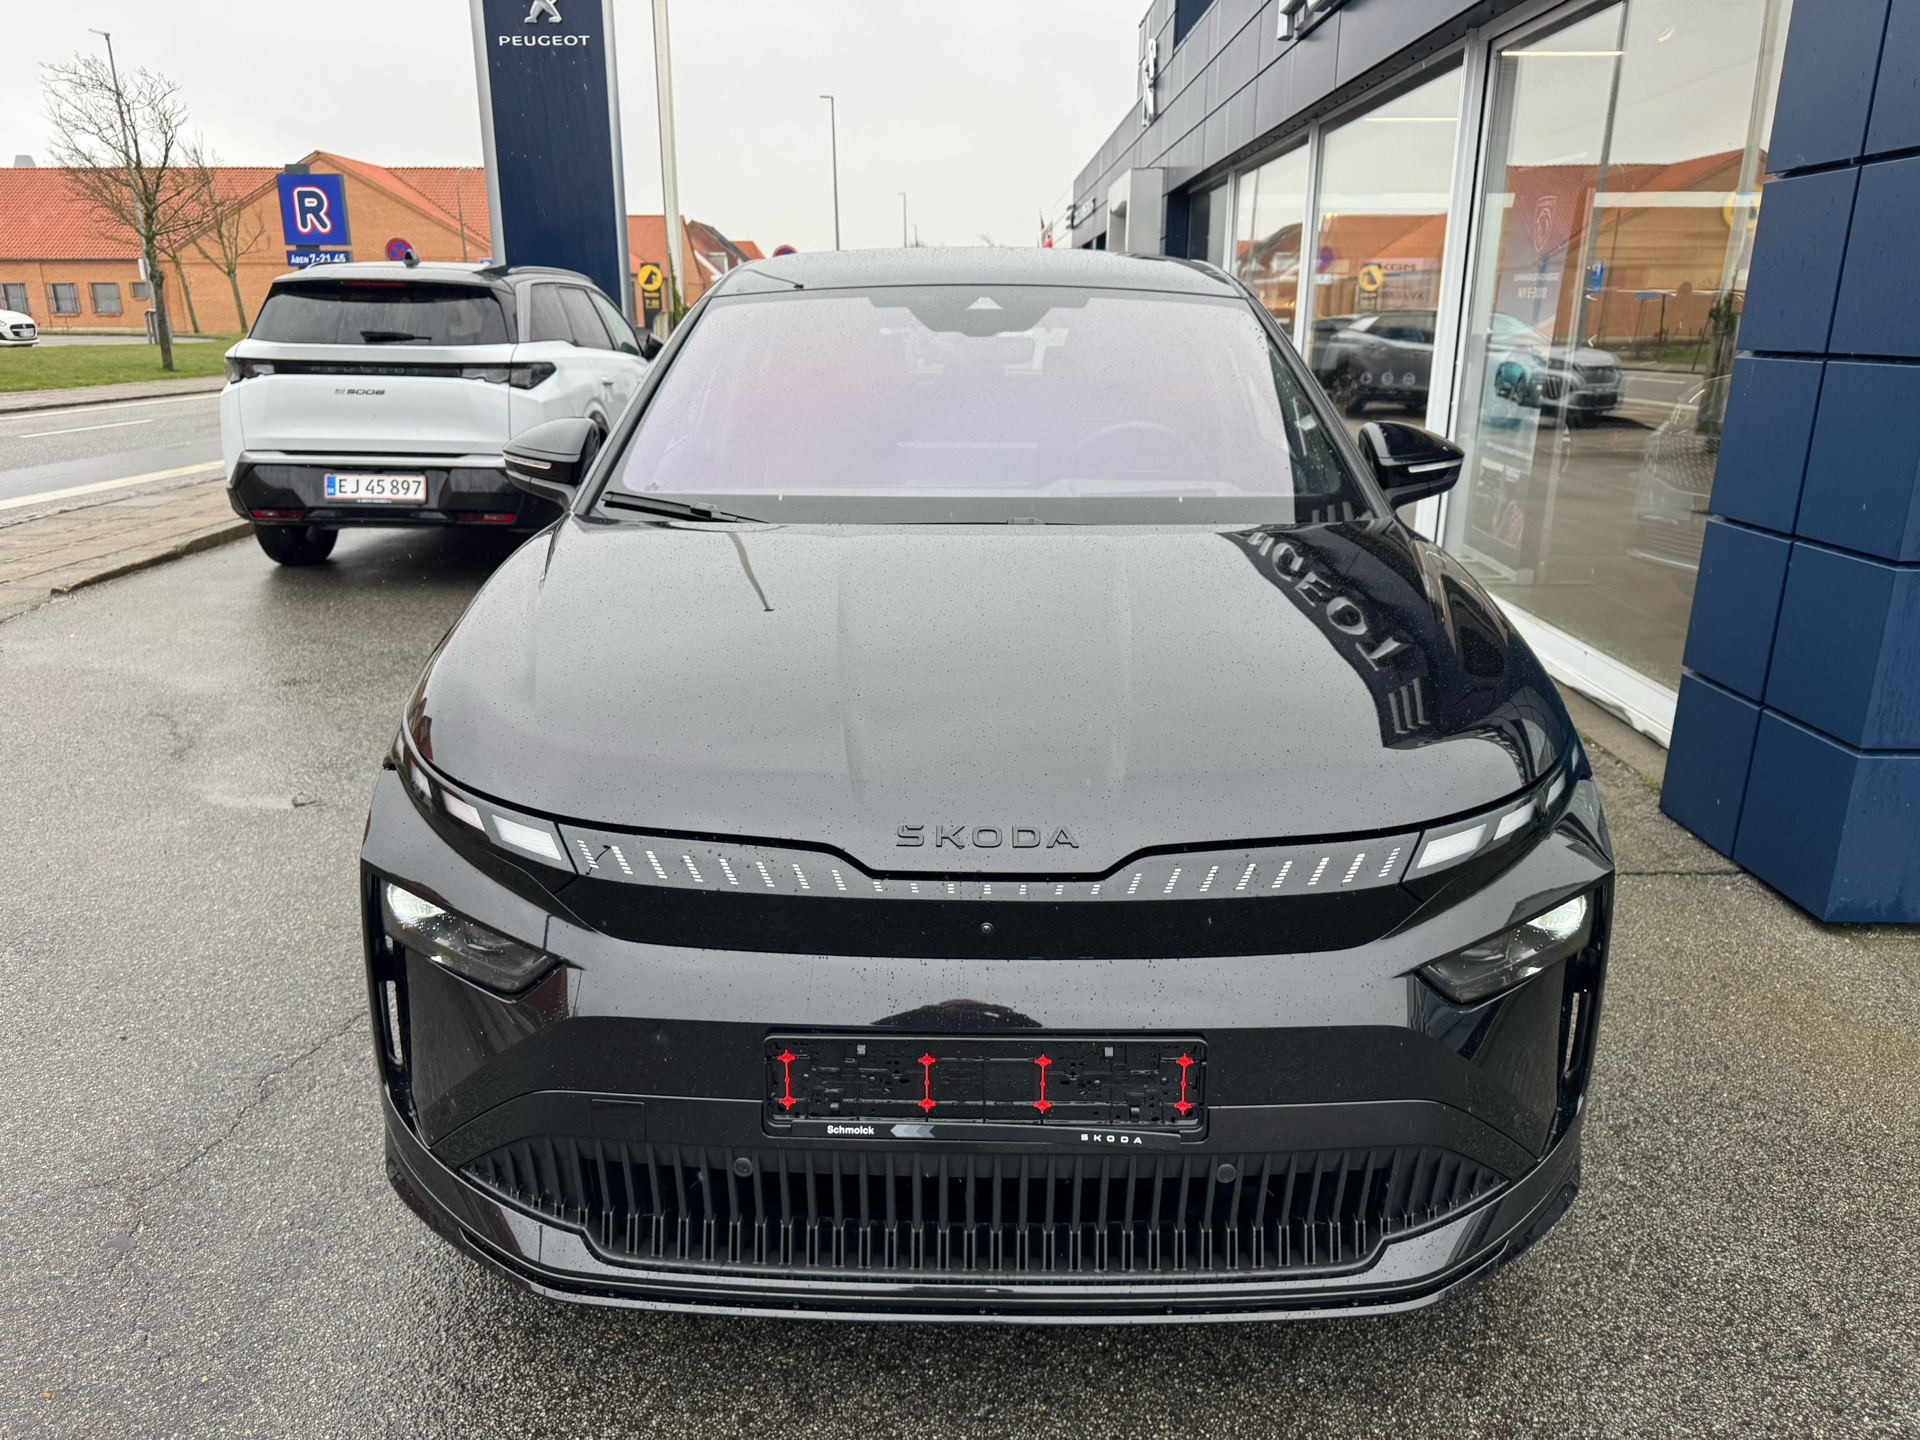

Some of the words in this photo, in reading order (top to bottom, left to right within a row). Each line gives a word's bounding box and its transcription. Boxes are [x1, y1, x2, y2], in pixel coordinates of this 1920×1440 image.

[499, 35, 590, 46] PEUGEOT
[292, 185, 332, 234] R
[338, 478, 360, 495] EJ
[365, 479, 386, 495] 45
[390, 479, 422, 496] 897
[826, 1124, 875, 1136] Schmolck
